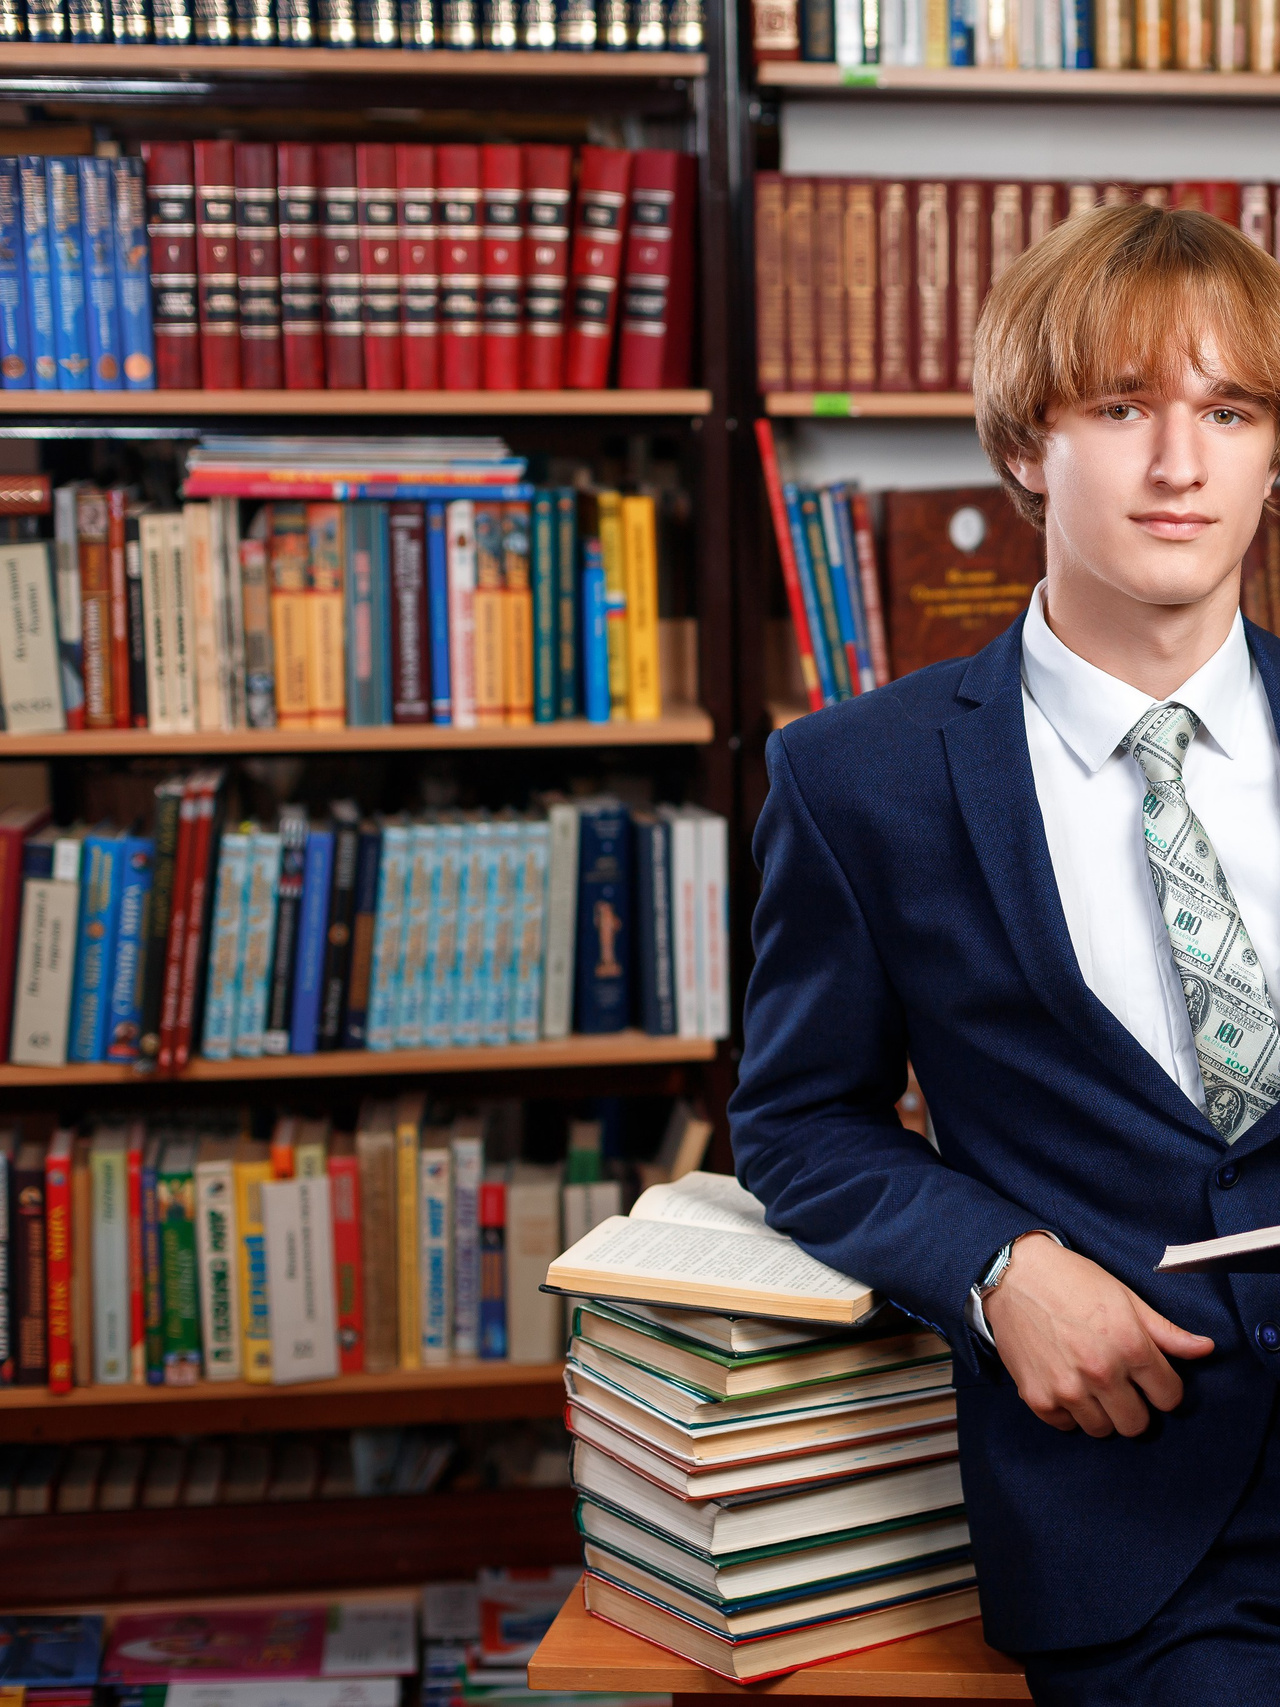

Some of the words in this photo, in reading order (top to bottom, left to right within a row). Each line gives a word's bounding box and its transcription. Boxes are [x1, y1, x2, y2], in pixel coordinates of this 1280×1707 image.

[1179, 861, 1205, 884] 100
[1173, 907, 1202, 935] 100
[1185, 944, 1211, 962] 100
[1225, 973, 1252, 994] 100
[1240, 1002, 1273, 1026] 100
[1214, 1019, 1244, 1048] 100
[1219, 1064, 1247, 1085] DOLLARS
[1225, 1057, 1249, 1074] 100
